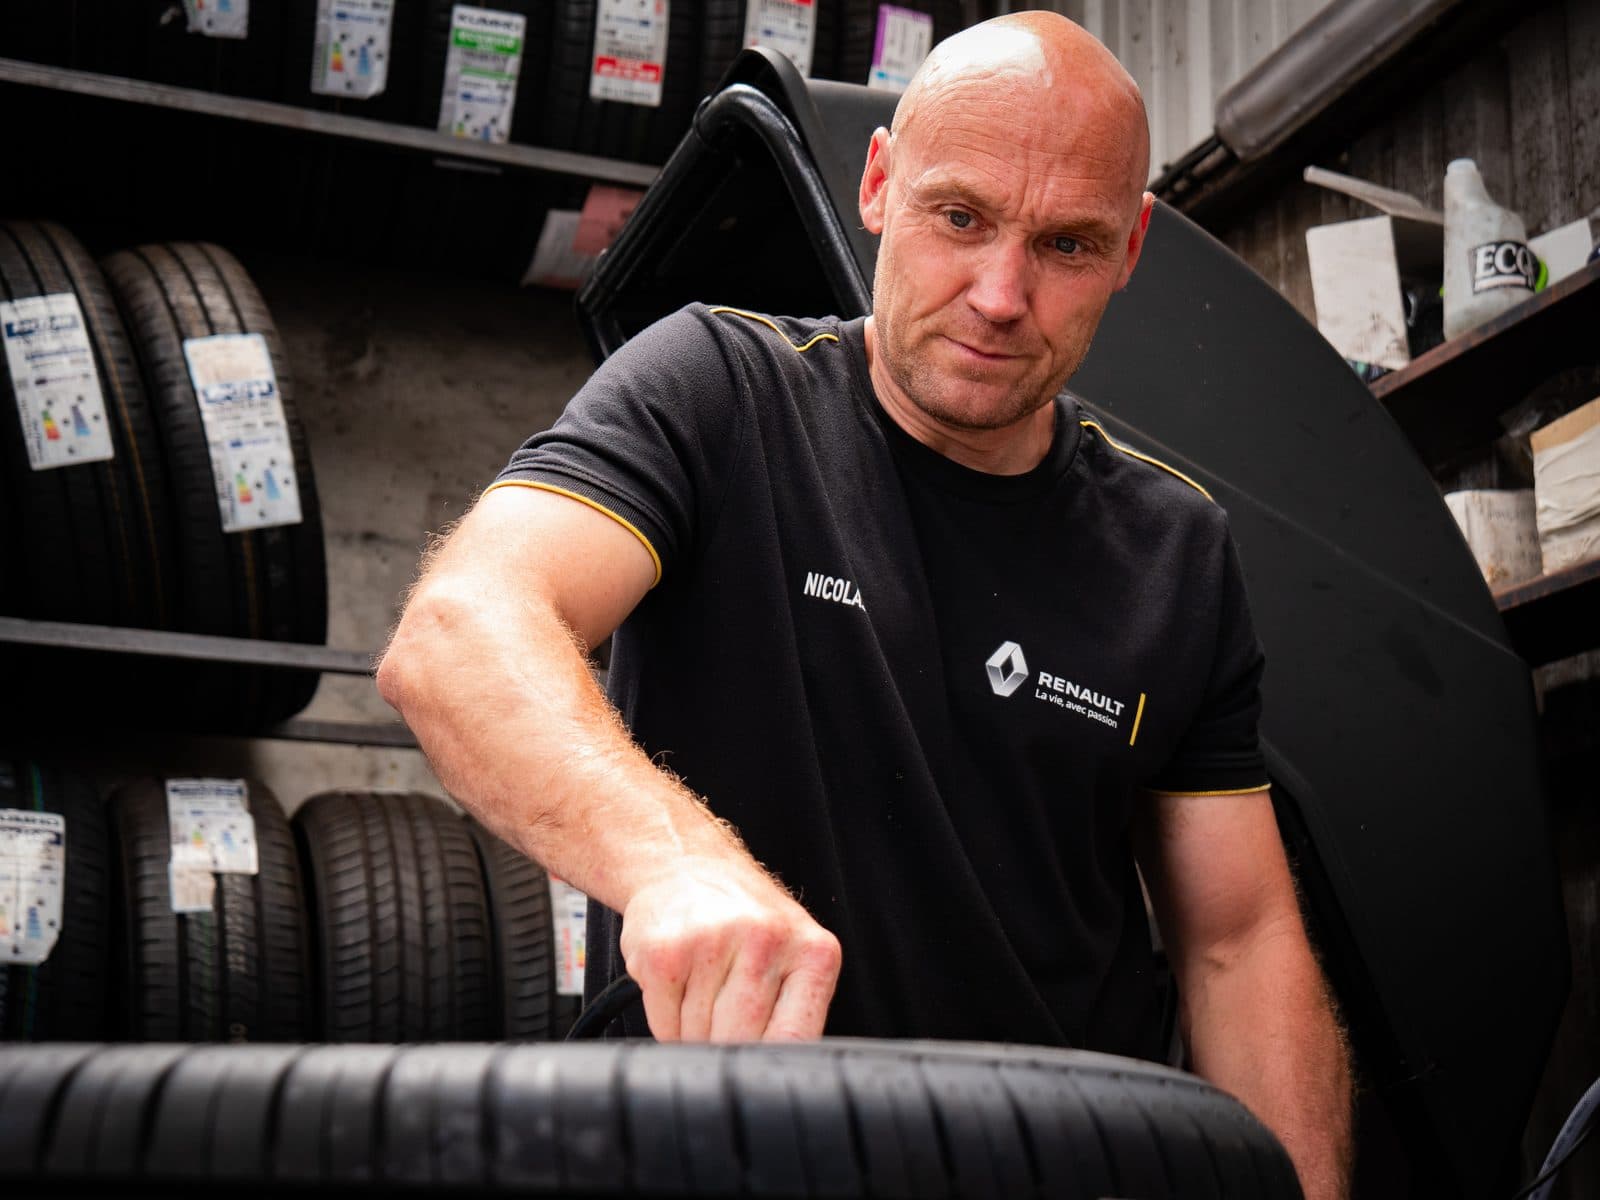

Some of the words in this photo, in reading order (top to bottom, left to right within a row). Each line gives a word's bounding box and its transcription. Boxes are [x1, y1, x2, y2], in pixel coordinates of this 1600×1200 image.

[803, 571, 866, 612] NICOLA
[1035, 688, 1048, 700] La
[1048, 693, 1065, 708] vie,
[1065, 700, 1087, 715] avec
[1087, 708, 1118, 729] passion
[1038, 671, 1125, 716] RENAULT
